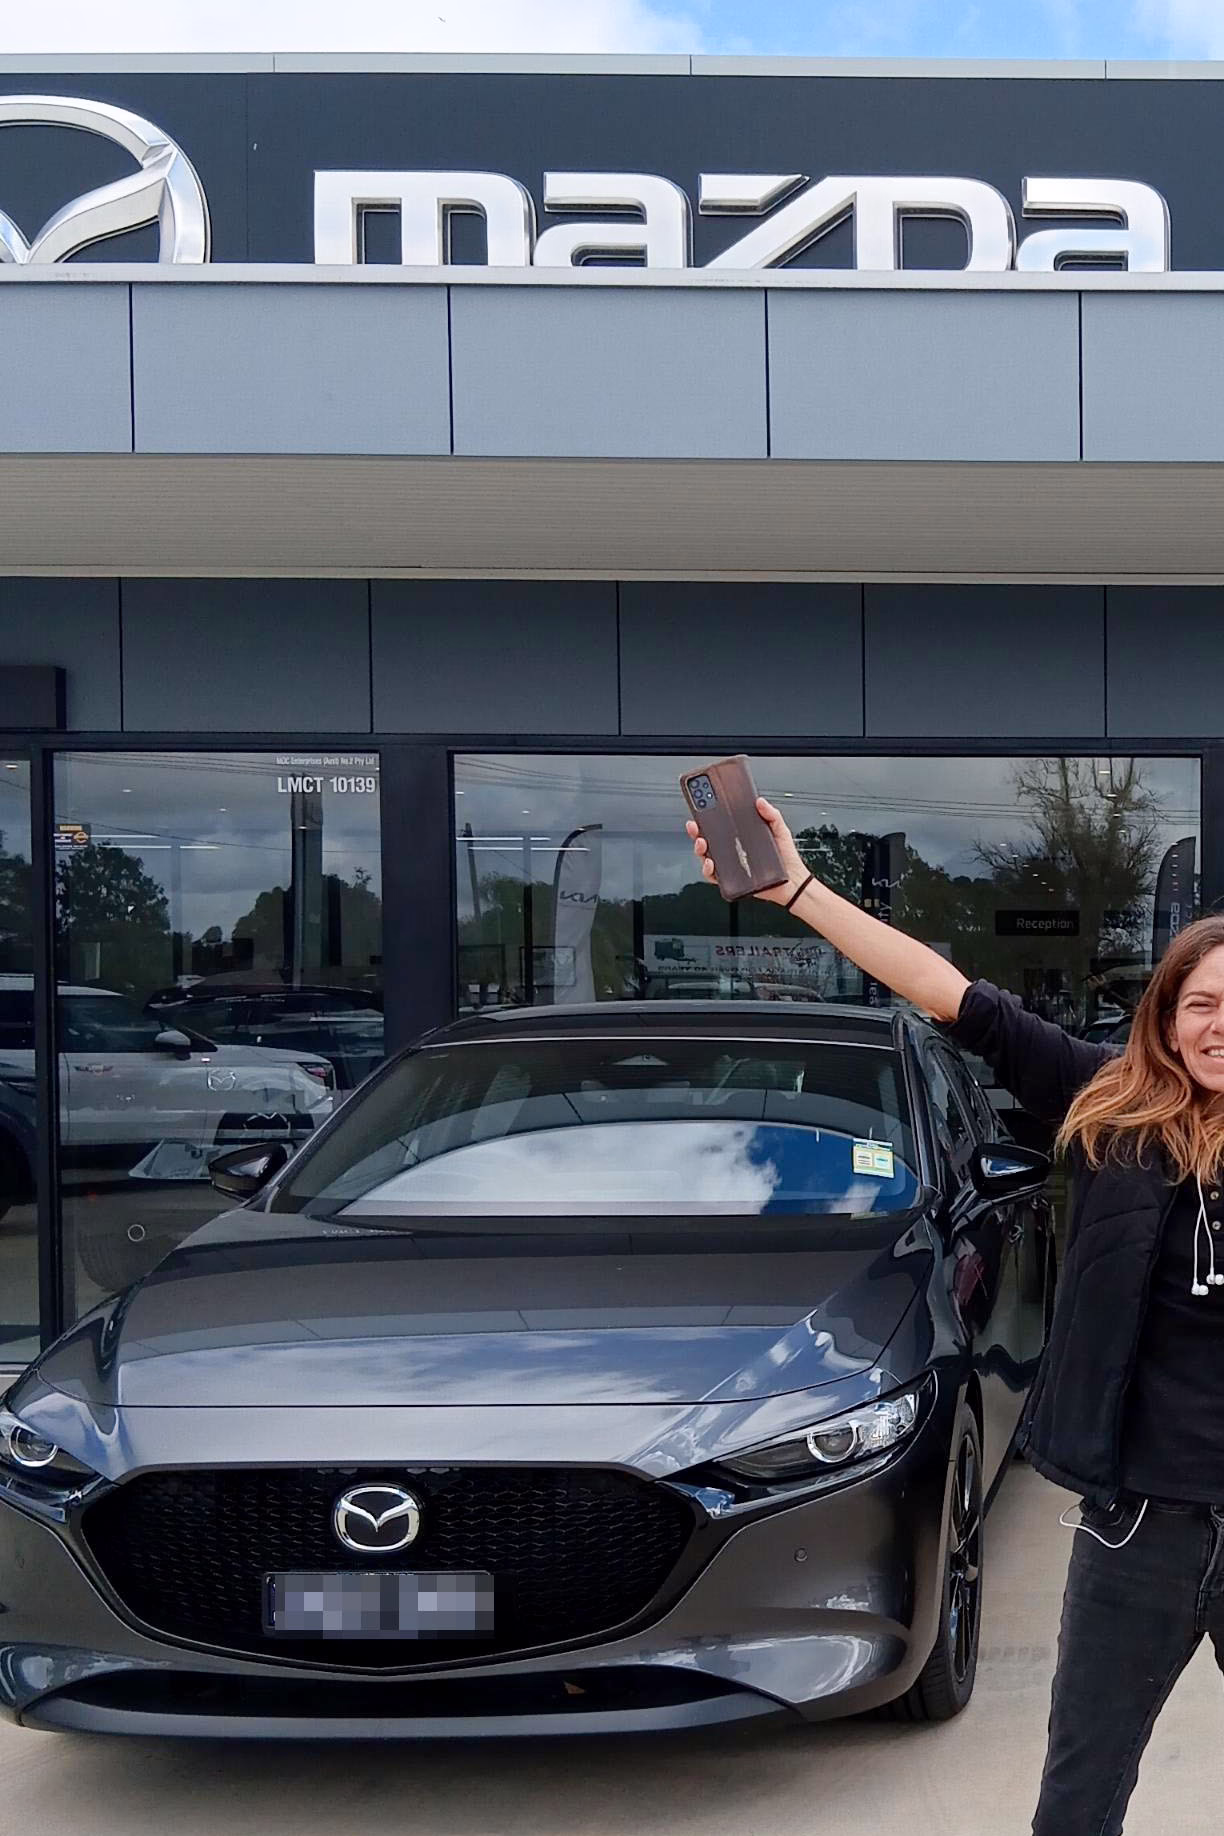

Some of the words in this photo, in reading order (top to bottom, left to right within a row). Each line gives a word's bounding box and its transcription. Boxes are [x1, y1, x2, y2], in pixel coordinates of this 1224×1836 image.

[314, 169, 1170, 273] mazda
[277, 776, 324, 793] LMCT
[329, 776, 376, 793] 10139
[1016, 917, 1075, 933] Reception
